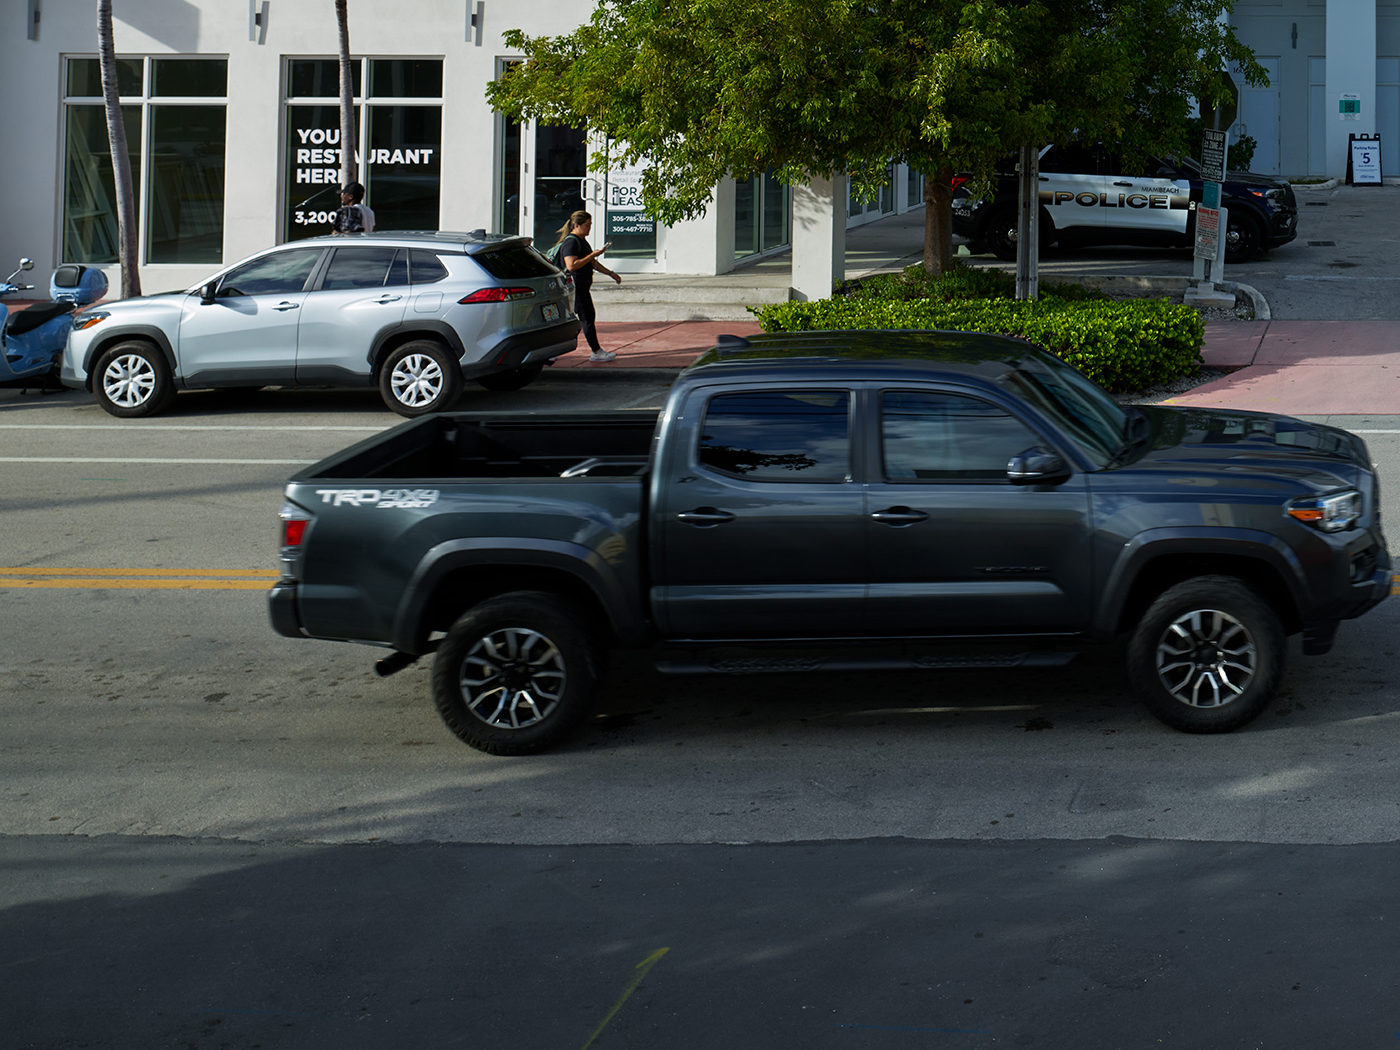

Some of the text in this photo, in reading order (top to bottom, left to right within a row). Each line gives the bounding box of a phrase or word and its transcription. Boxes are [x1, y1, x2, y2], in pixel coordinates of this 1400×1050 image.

[296, 128, 341, 145] YOU
[612, 186, 638, 196] FOR
[612, 197, 643, 206] LEAS
[1054, 191, 1169, 209] POLICE
[294, 211, 338, 226] 3,200
[315, 489, 381, 506] TRD
[375, 500, 436, 508] SPORT
